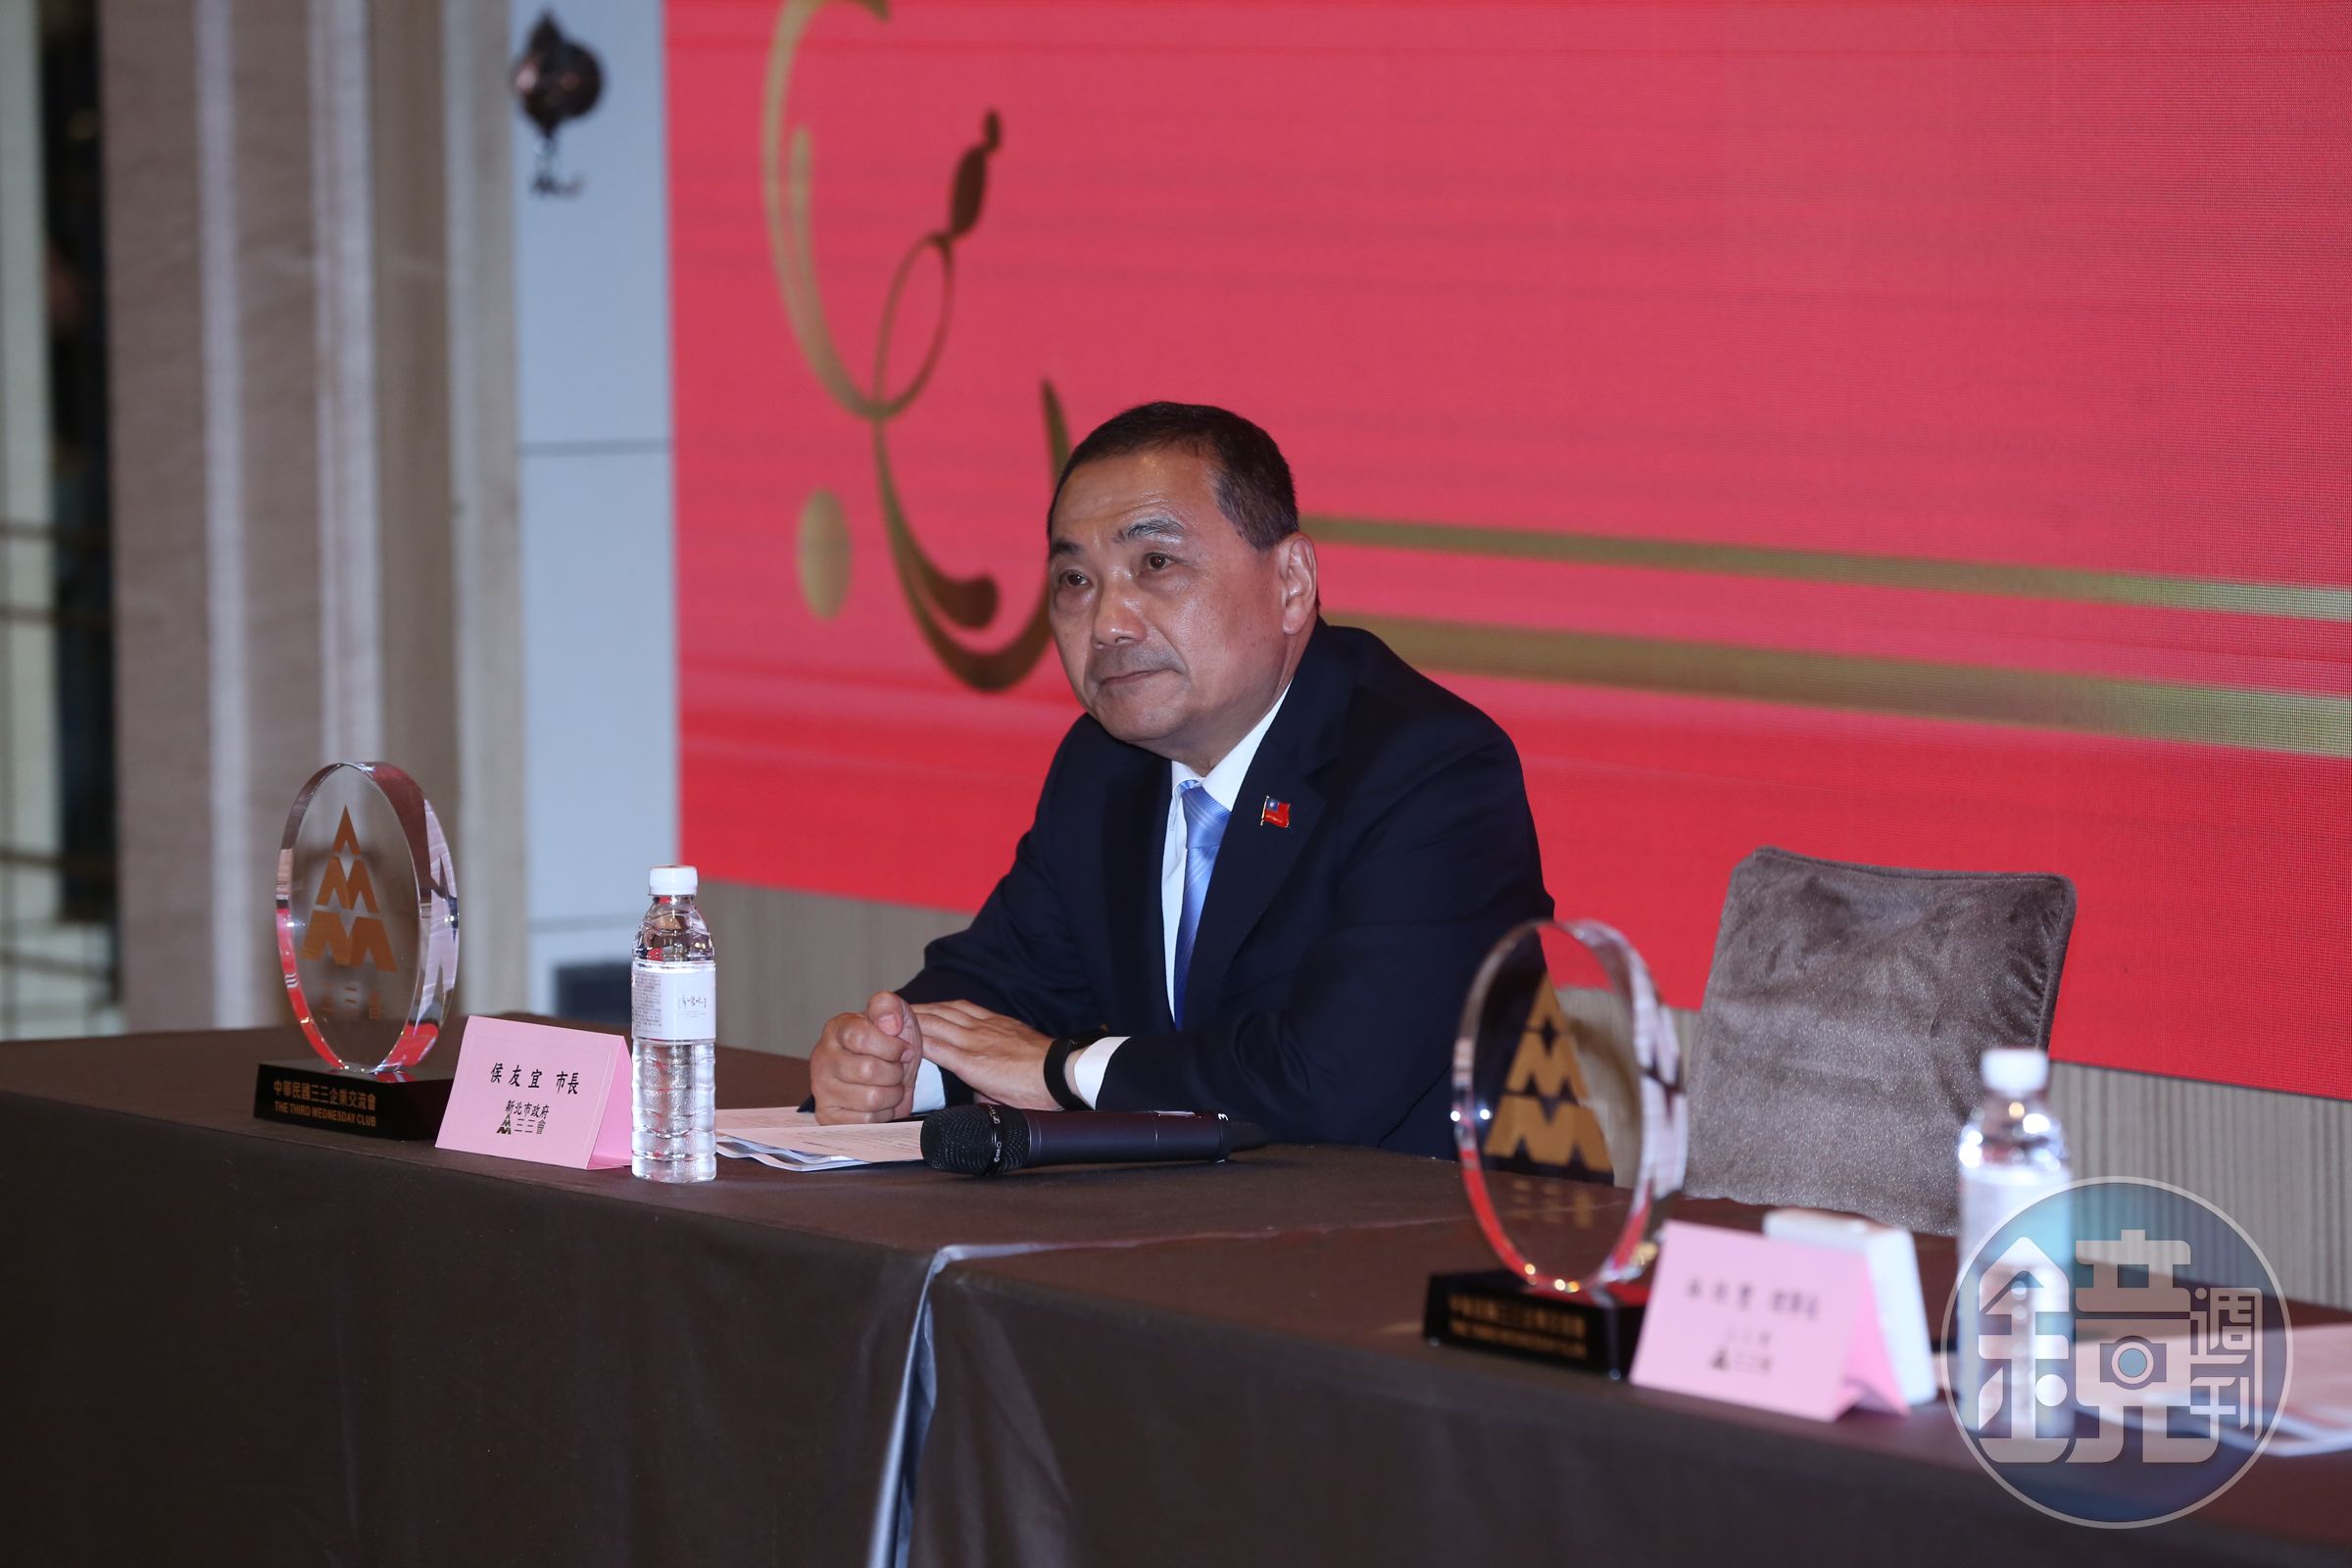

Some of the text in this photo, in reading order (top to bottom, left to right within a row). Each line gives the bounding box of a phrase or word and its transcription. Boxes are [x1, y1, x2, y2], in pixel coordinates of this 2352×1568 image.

[556, 1070, 579, 1096] 市長
[274, 1100, 377, 1128] THE THIRD WEDNESDAY CLUB
[505, 1099, 550, 1120] 新北市政府
